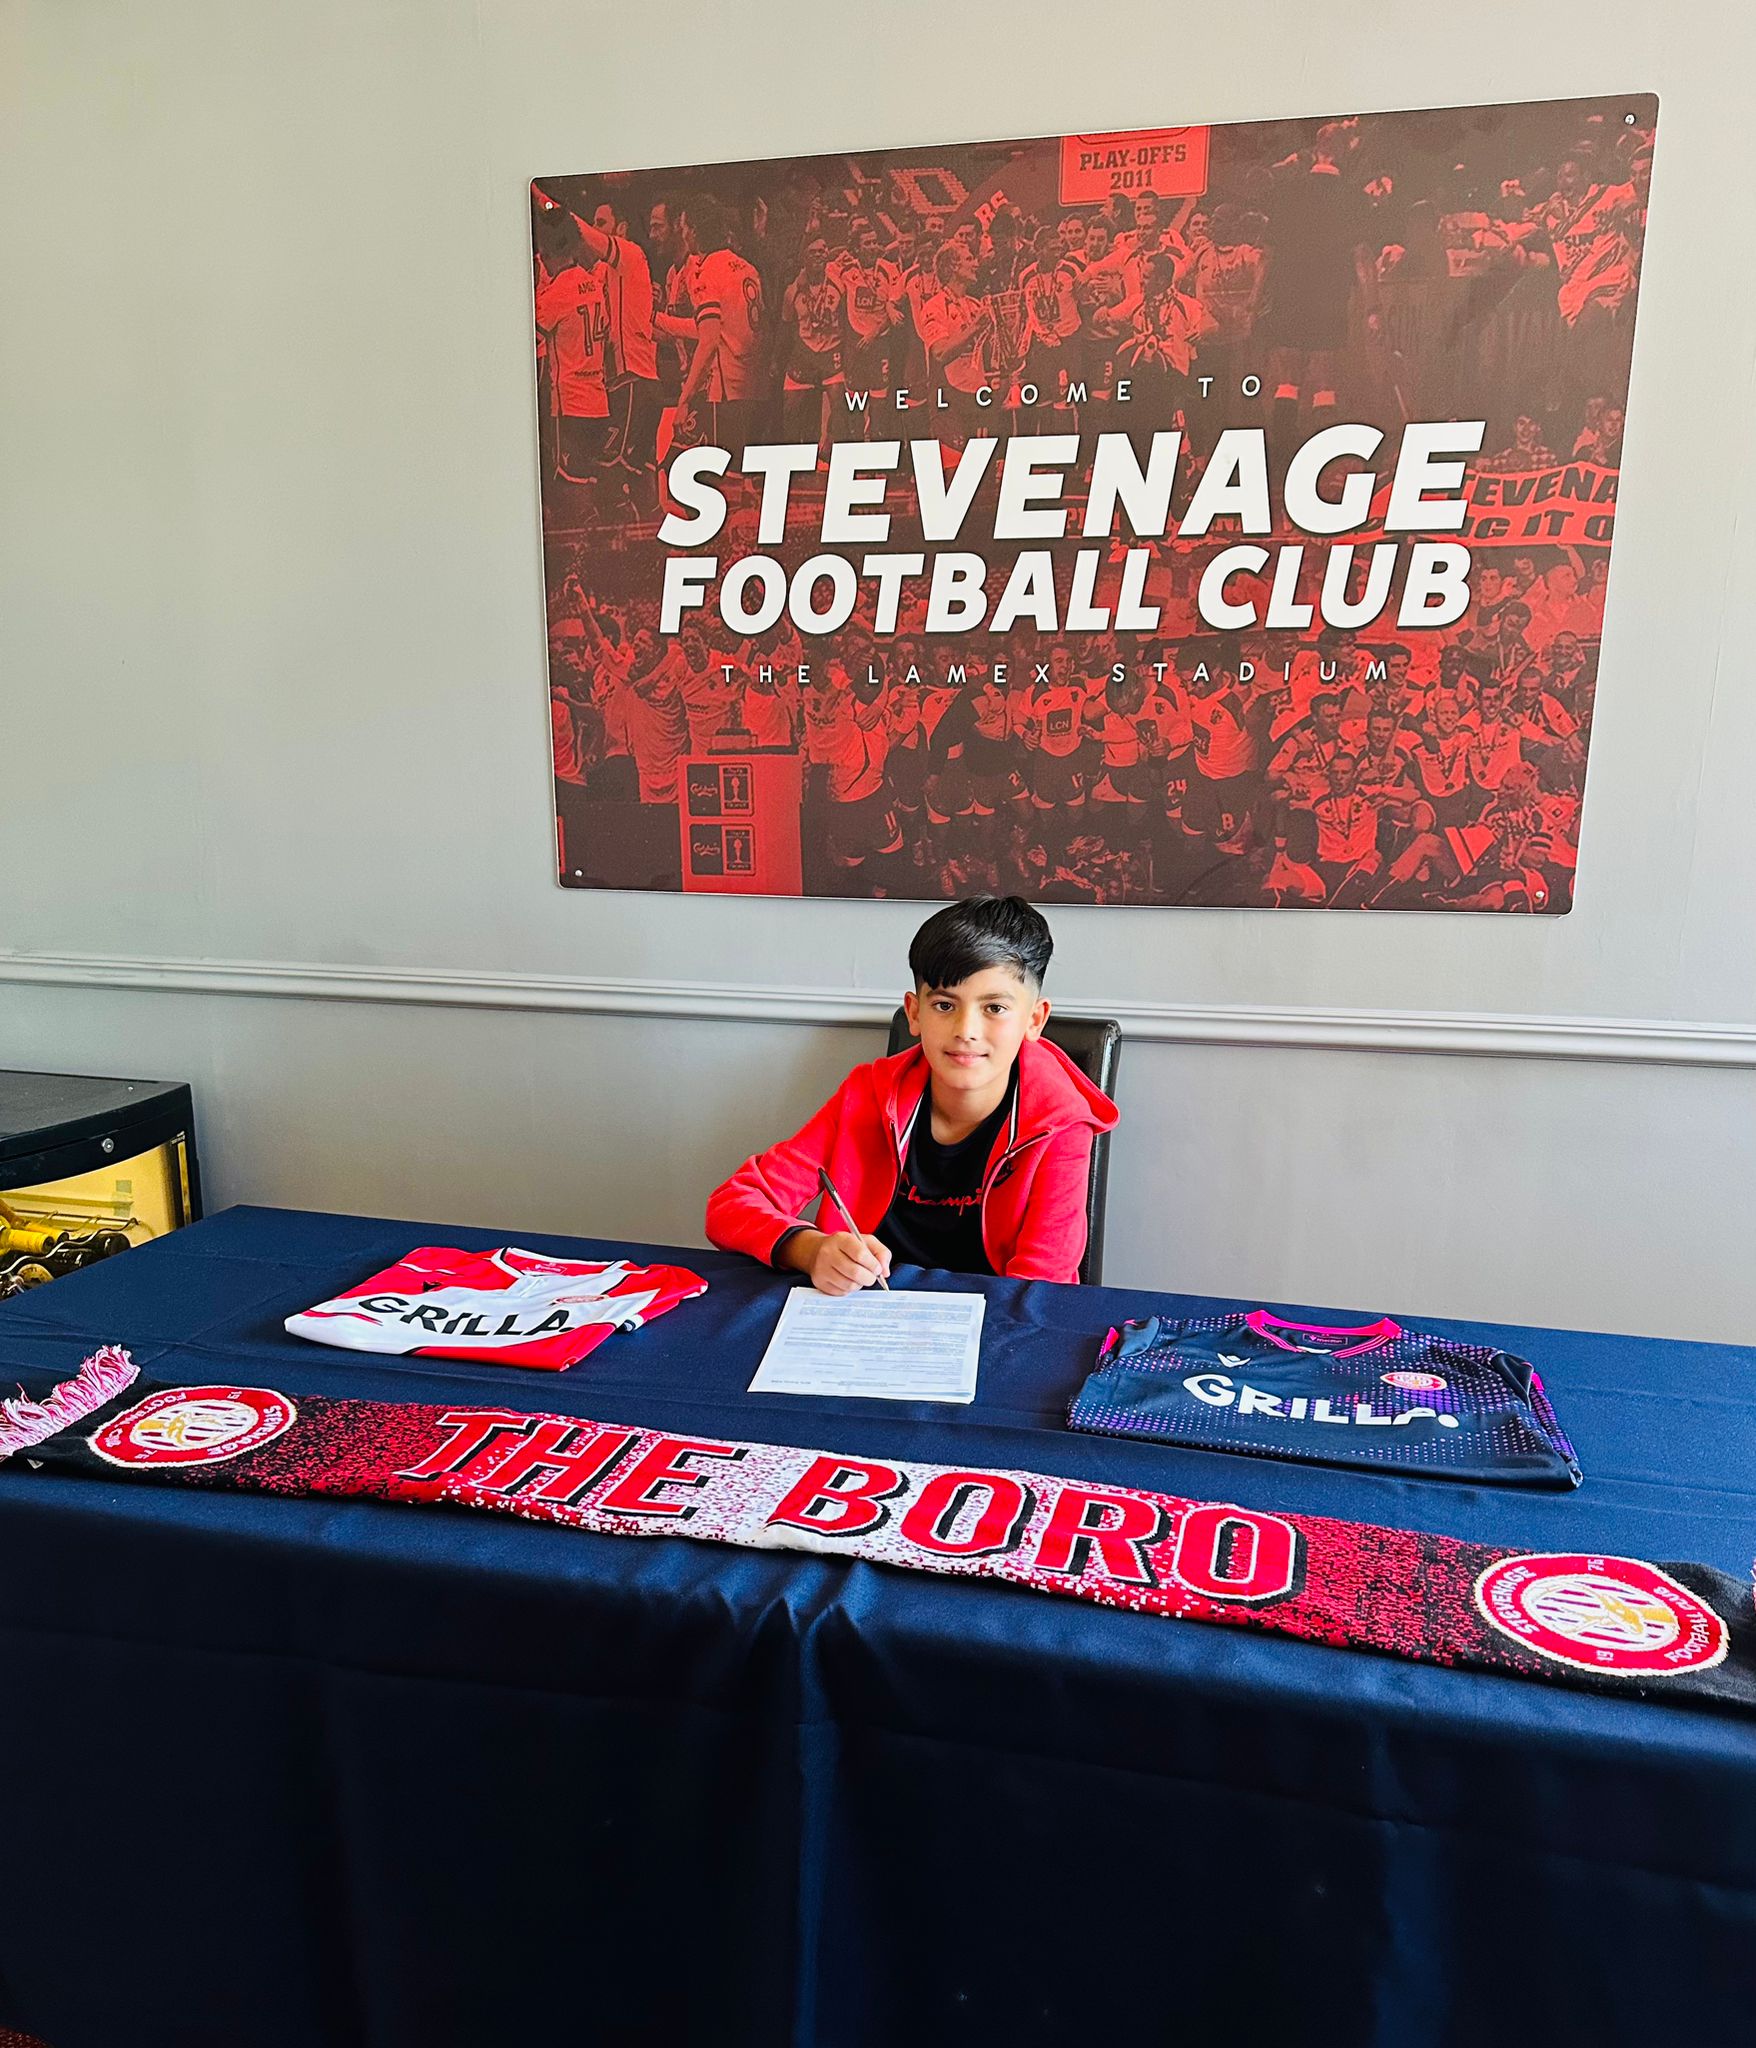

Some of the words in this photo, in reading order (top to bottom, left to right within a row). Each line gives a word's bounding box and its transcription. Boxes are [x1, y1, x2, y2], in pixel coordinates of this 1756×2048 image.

[1080, 144, 1187, 171] PLAY-OFFS
[1110, 168, 1153, 190] 2011
[577, 302, 605, 357] 14
[845, 381, 1131, 411] WELCOME
[1199, 375, 1261, 399] TO
[657, 421, 1486, 547] STEVENAGE
[1521, 509, 1574, 537] IT
[659, 548, 1161, 635] FOOTBALL
[1197, 543, 1472, 631] CLUB
[721, 664, 811, 684] THE
[868, 663, 1051, 684] LAMEX
[1112, 661, 1388, 684] STADIUM
[1049, 718, 1070, 731] LCN
[1167, 778, 1187, 797] 24
[206, 1405, 284, 1456] STEVENAGE
[400, 1408, 749, 1519] THE
[765, 1454, 1307, 1606] BORO
[1491, 1566, 1540, 1635] STEVENAGE
[1653, 1586, 1697, 1612] CLUB
[1664, 1612, 1709, 1663] FOOTBALL
